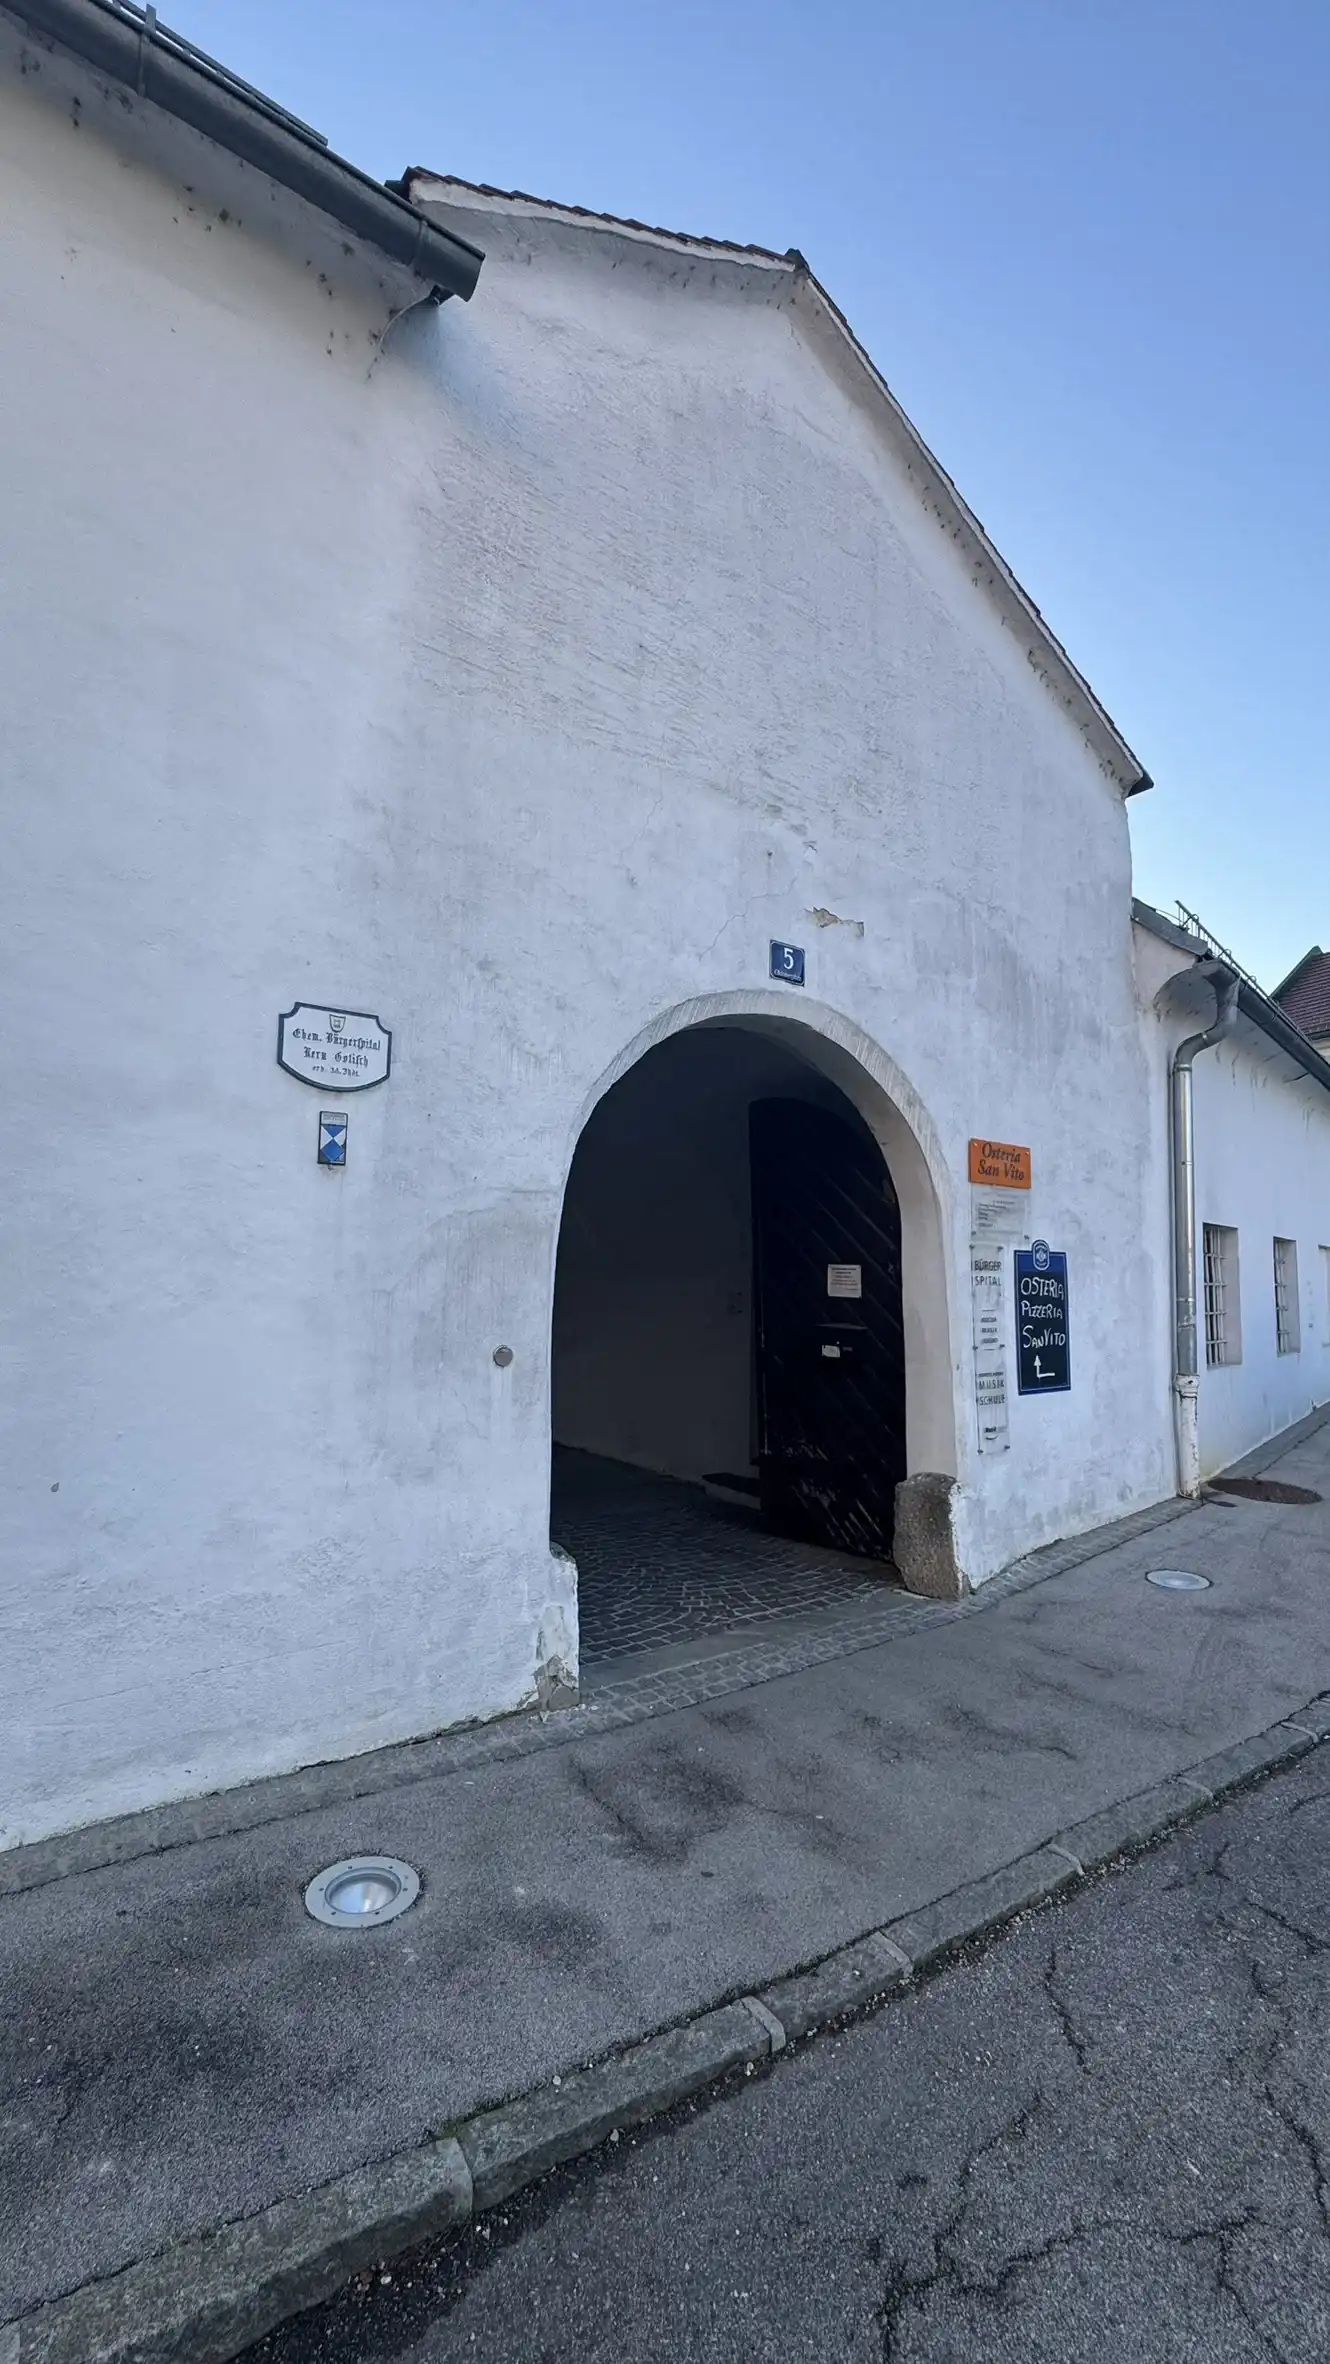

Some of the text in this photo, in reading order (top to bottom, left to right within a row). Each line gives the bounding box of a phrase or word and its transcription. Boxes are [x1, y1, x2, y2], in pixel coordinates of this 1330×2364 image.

[783, 947, 794, 970] 5
[982, 1142, 1021, 1164] Osteria
[978, 1159, 1025, 1181] San Vito
[974, 1258, 1002, 1271] BÜRGER
[975, 1275, 1002, 1286] SPITAL
[1020, 1277, 1064, 1301] OSTERIA
[1021, 1300, 1063, 1319] PIZZERIA
[979, 1379, 1005, 1390] MUSIK
[979, 1394, 1006, 1406] SCHULE
